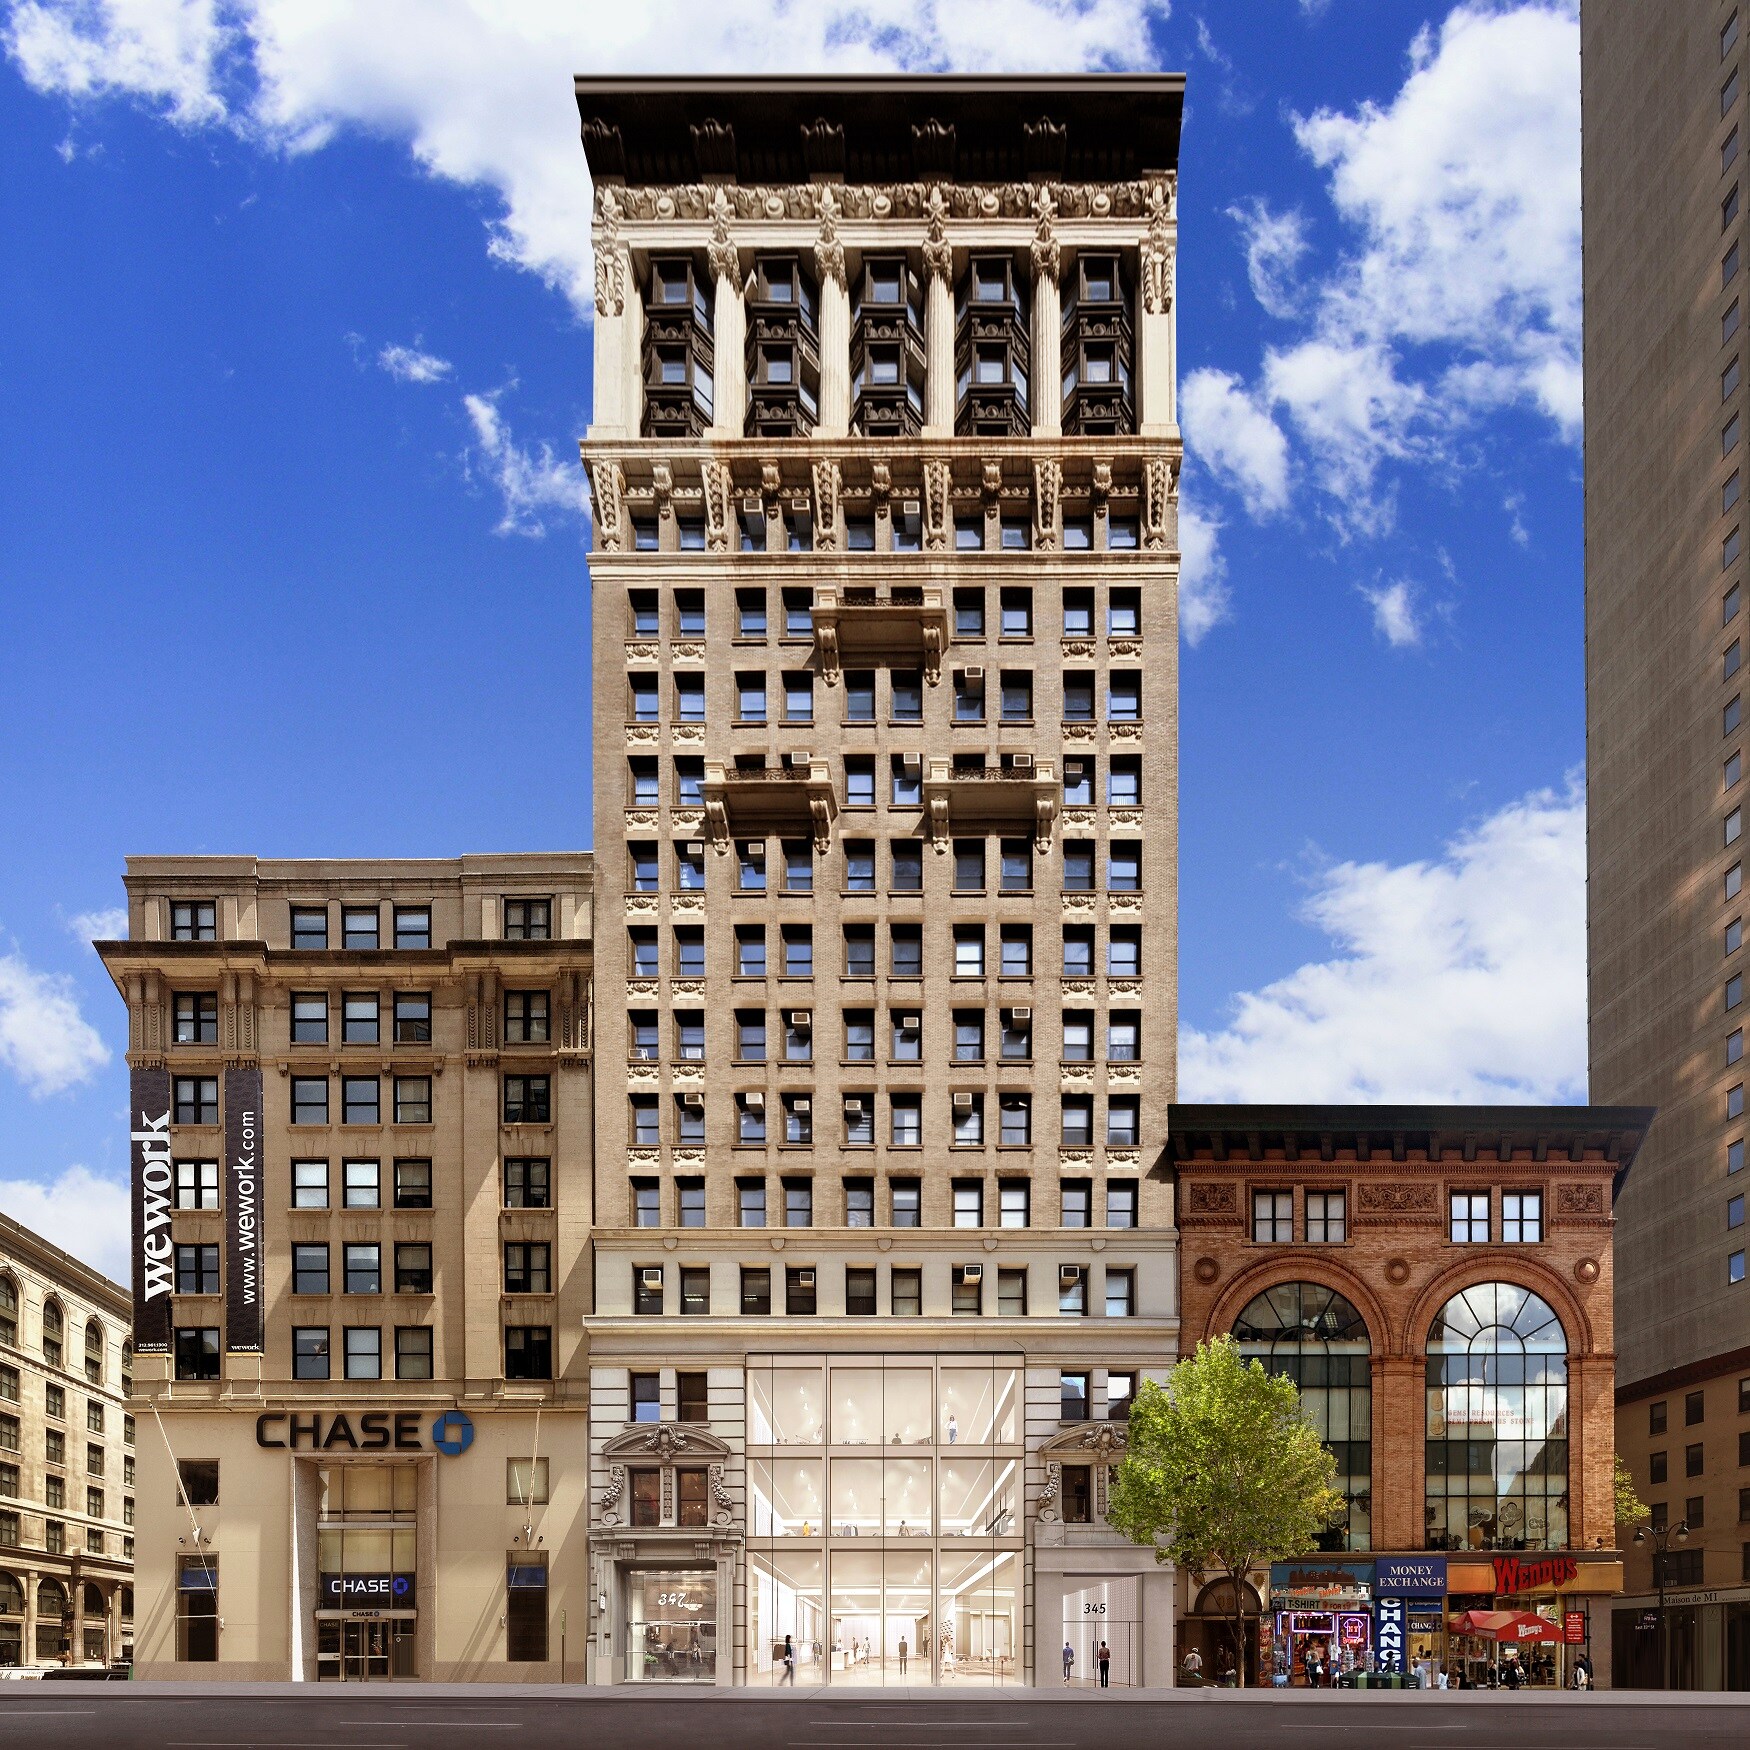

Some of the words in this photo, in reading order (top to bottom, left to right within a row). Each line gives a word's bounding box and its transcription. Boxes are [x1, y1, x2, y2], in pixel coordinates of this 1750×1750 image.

[131, 1110, 173, 1302] wework
[233, 1111, 256, 1305] www.wework.com
[256, 1414, 422, 1448] CHASE
[1390, 1565, 1433, 1576] MONEY
[331, 1579, 390, 1593] CHASE
[1380, 1577, 1445, 1587] EXCHANGE
[657, 1592, 687, 1608] 347
[1664, 1595, 1691, 1604] Maison
[1692, 1594, 1702, 1603] de
[1083, 1603, 1107, 1614] 345
[1288, 1600, 1320, 1610] T-SHIRT
[1411, 1621, 1435, 1630] CHANG
